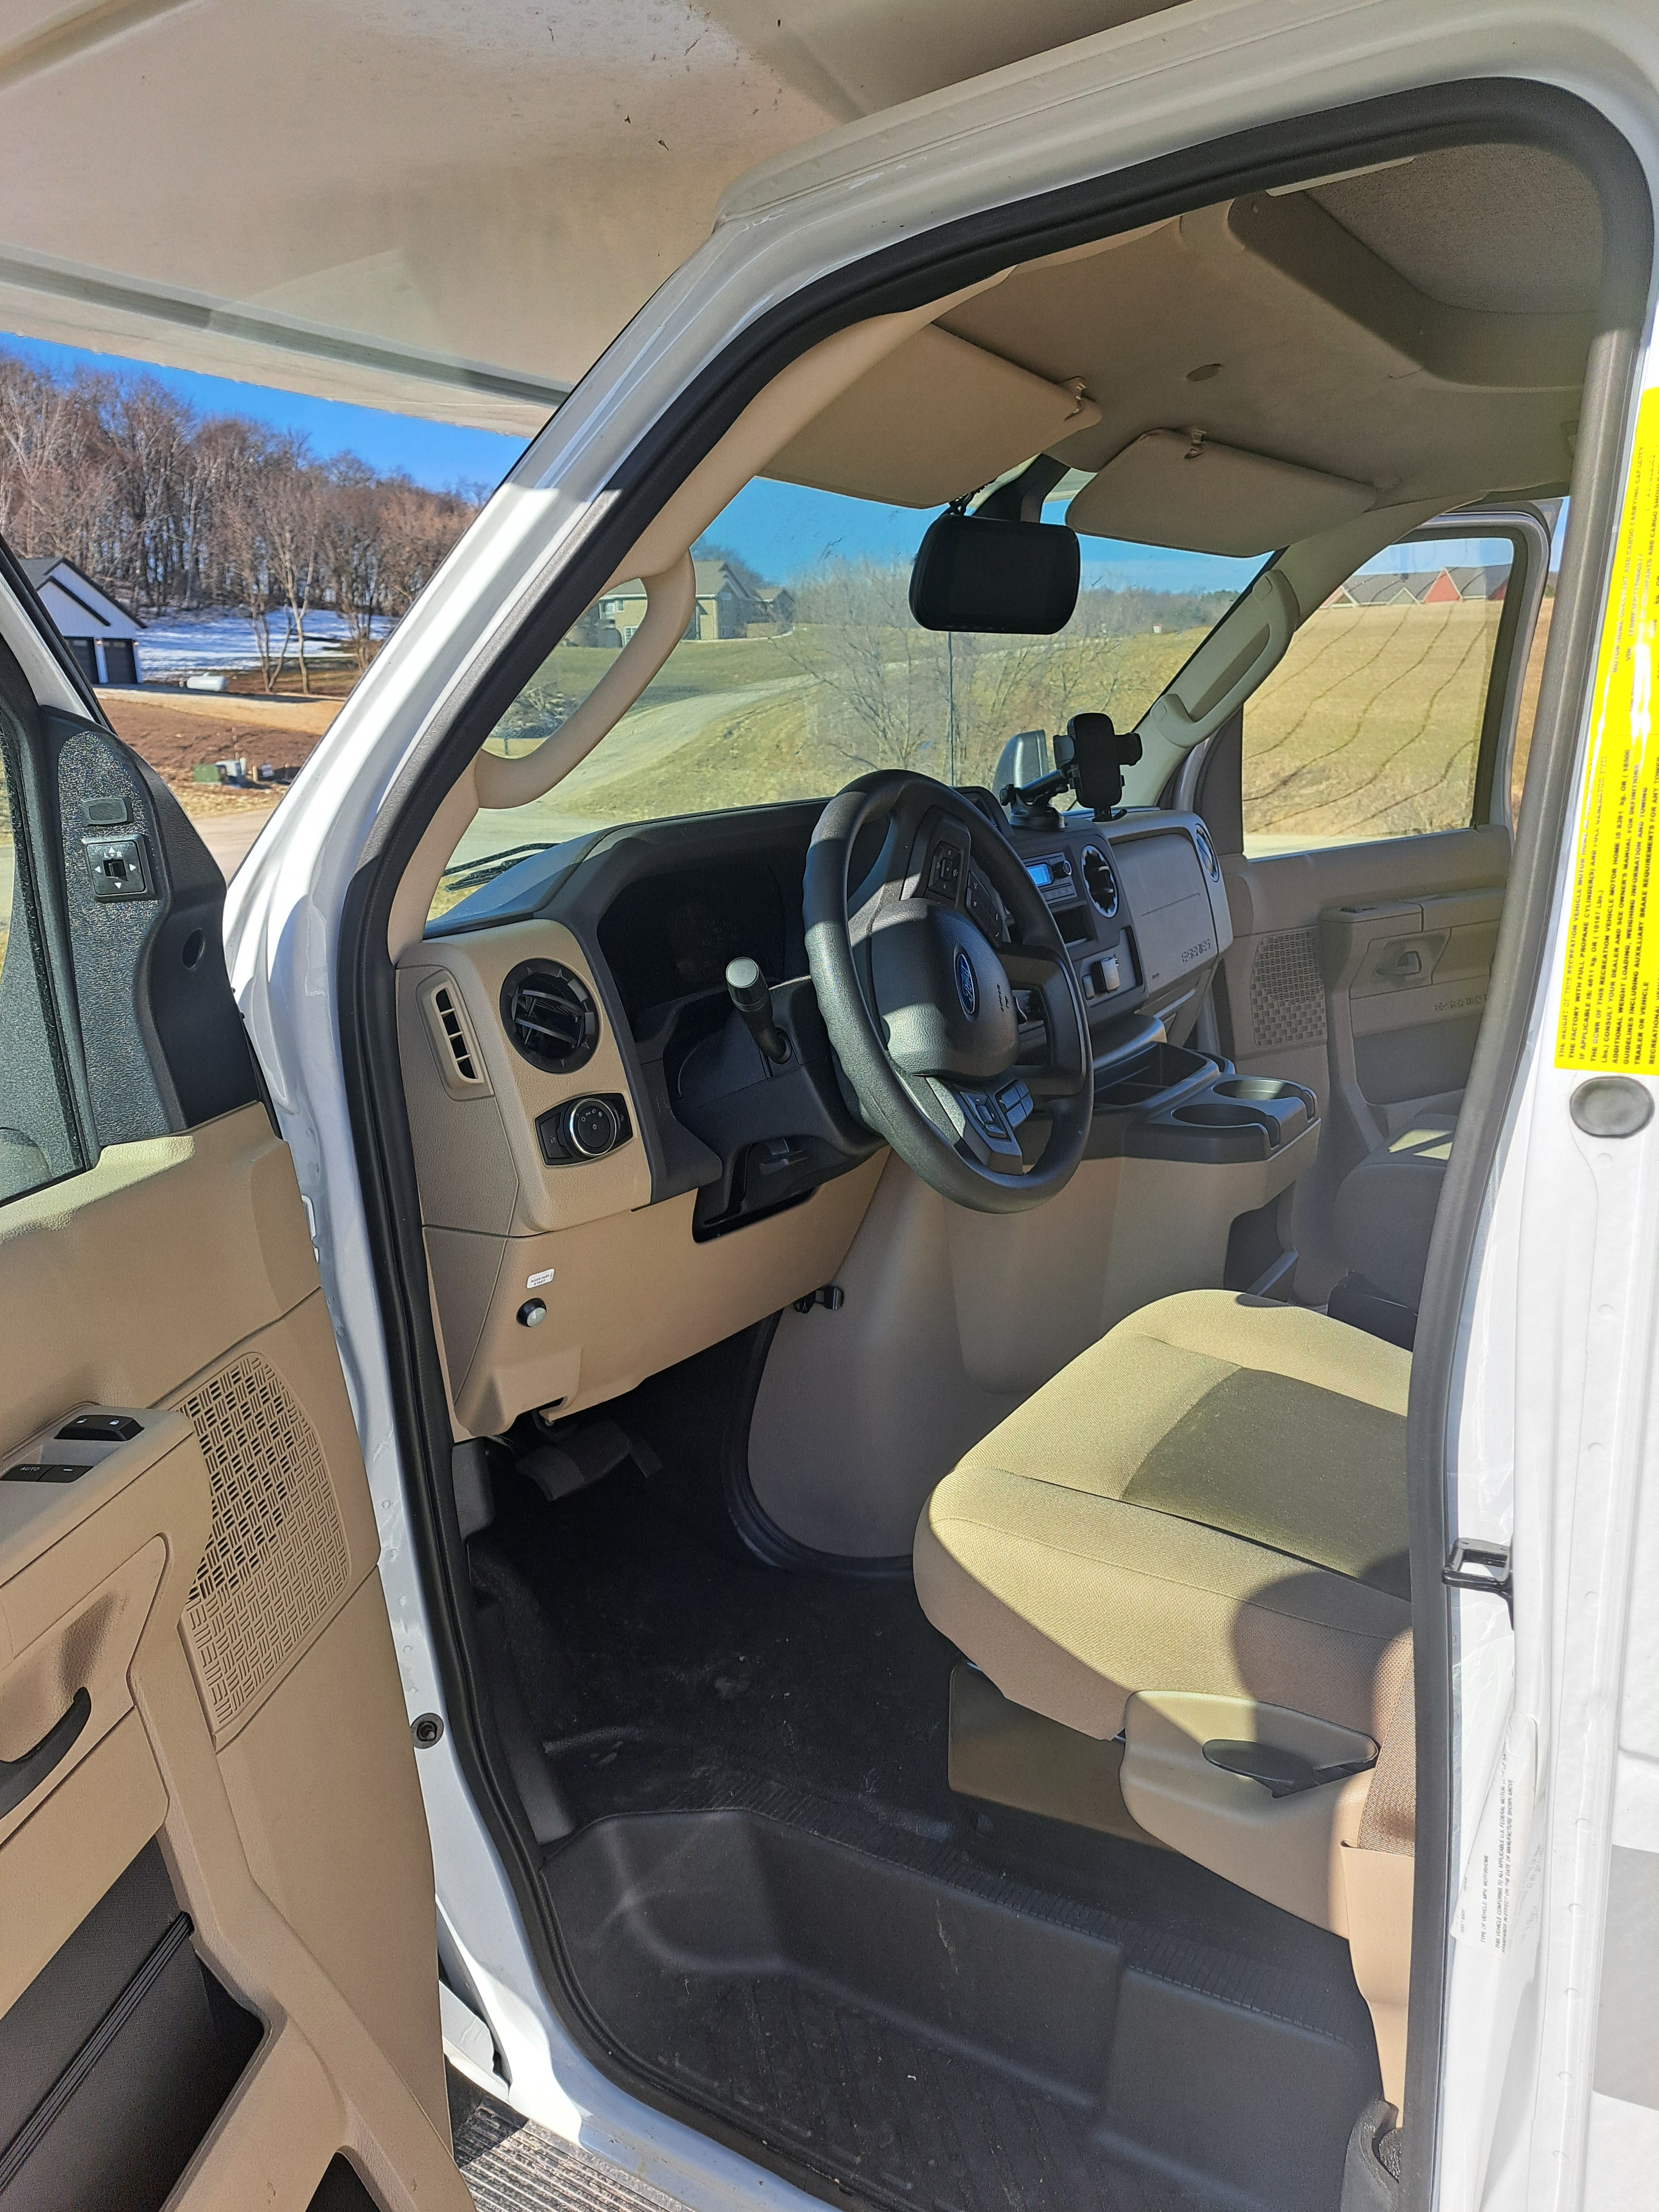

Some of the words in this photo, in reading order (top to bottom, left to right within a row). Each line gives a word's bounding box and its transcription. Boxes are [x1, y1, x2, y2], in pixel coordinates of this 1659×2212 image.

[1635, 447, 1644, 483] CAPACITY
[1629, 486, 1639, 525] CARRYING
[1649, 511, 1658, 537] CARGO
[1626, 528, 1634, 554] CARGO
[1618, 575, 1628, 617] OCCUPANT
[1612, 645, 1620, 673] MOTOR
[1622, 749, 1630, 772] 18500
[1620, 780, 1627, 791] OR
[1639, 787, 1648, 817] TOWING
[1580, 832, 1588, 855] HOME
[1622, 837, 1631, 869] MANUAL
[1642, 825, 1655, 887] REQUIREMENTS
[1576, 858, 1585, 885] MOTOR
[1609, 868, 1617, 896] MOTOR
[1630, 841, 1642, 896] INFORMATION
[1572, 888, 1582, 921] VEHICLE
[1596, 890, 1604, 908] Lbs.)
[1618, 873, 1627, 908] OWNER'S
[1639, 890, 1648, 917] BRAKE
[1570, 1006, 1580, 1040] FACTORY
[1579, 921, 1589, 957] PROPANE
[1584, 868, 1595, 918] CYLINDER(S)
[1594, 777, 1604, 824] GENERATOR
[1593, 911, 1601, 933] 10167
[1604, 898, 1614, 931] VEHICLE
[1626, 899, 1636, 939] WEIGHING
[1567, 925, 1578, 974] RECREATION
[1591, 941, 1597, 952] OR
[1599, 935, 1610, 985] RECREATION
[1621, 942, 1632, 980] LOADING,
[1610, 947, 1619, 978] DEALER
[1617, 983, 1626, 1013] WEIGHT
[1628, 971, 1639, 1014] INCLUDING
[1639, 981, 1649, 1015] VEHICLE
[1559, 1009, 1569, 1040] WEIGHT
[1580, 1003, 1591, 1050] APPLICABLE
[1595, 1008, 1602, 1018] OF
[1603, 1006, 1613, 1041] CONSULT
[1638, 1018, 1645, 1029] OR
[1592, 1021, 1600, 1044] GCWR
[1612, 1016, 1623, 1063] ADDITIONAL
[1623, 1017, 1634, 1064] GUIDELINES
[1601, 1044, 1609, 1062] Lbs.)
[1634, 1032, 1643, 1065] TRAILER
[1504, 1888, 1509, 1896] ON
